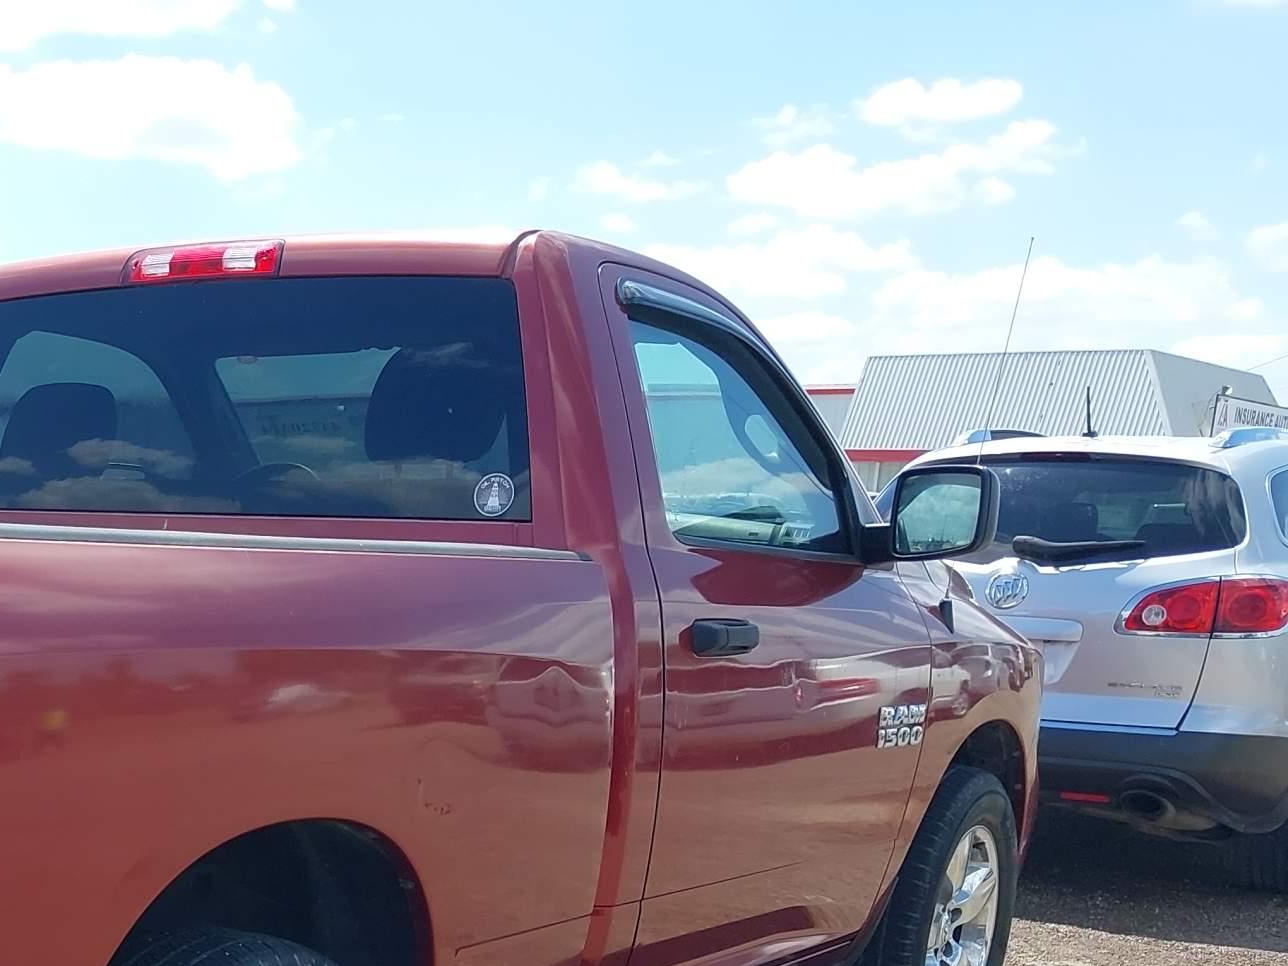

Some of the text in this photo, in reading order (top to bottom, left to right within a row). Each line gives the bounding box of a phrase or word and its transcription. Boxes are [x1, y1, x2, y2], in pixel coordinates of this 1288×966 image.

[1234, 406, 1274, 428] INSURANCE
[879, 703, 926, 727] RAM
[877, 725, 923, 749] 1500
